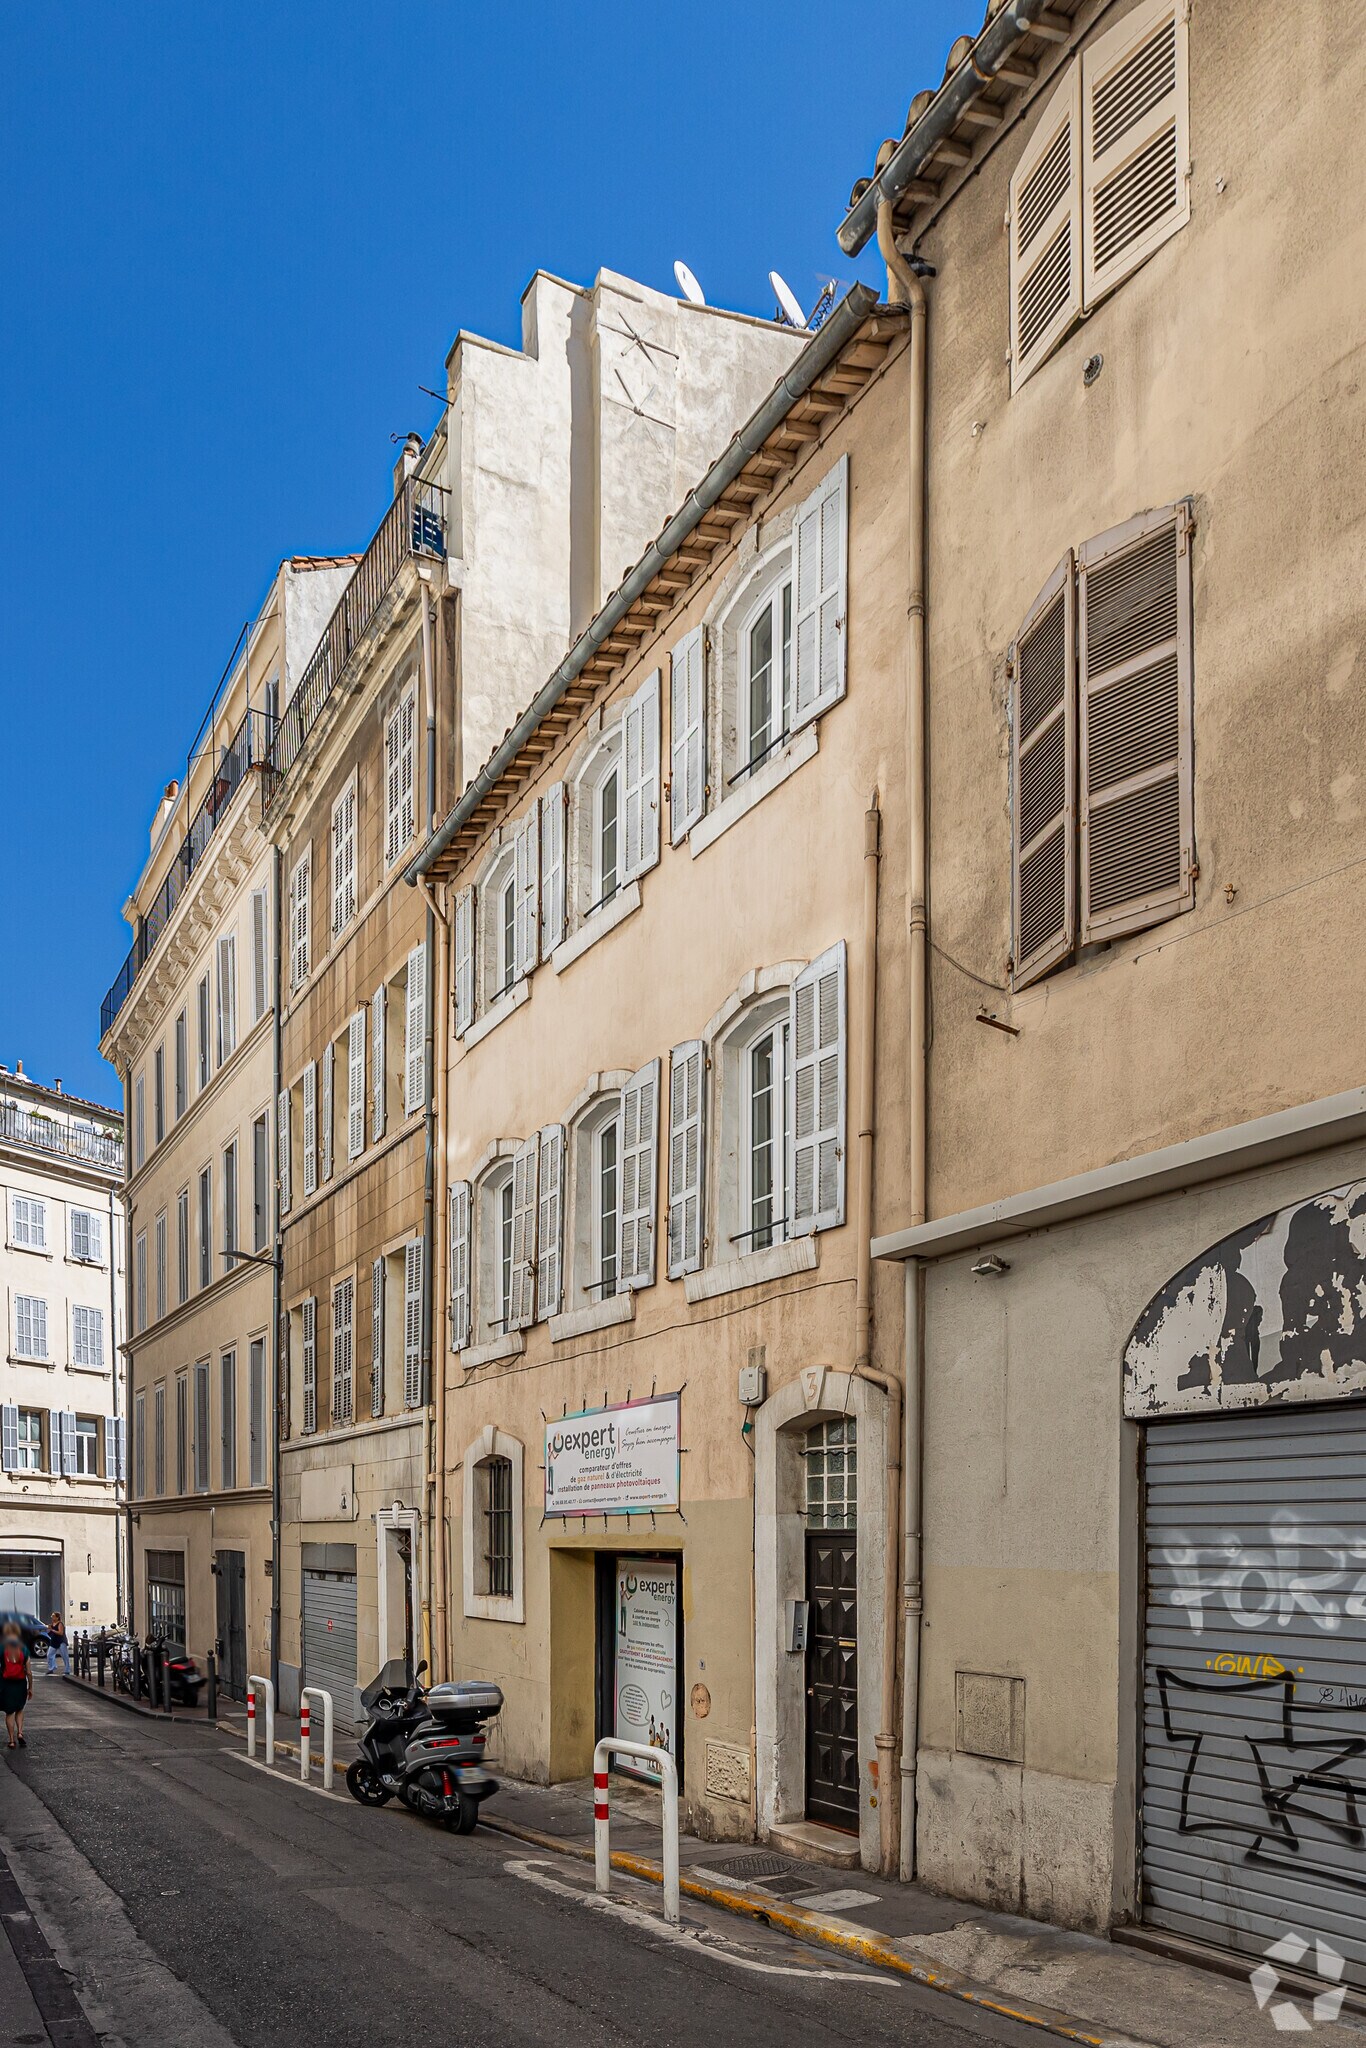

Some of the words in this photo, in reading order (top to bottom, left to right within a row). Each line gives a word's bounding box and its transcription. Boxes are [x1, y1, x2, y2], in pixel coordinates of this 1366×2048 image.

[806, 1372, 818, 1402] 3
[565, 1422, 615, 1454] expert
[584, 1446, 617, 1460] energy
[579, 1464, 610, 1474] comparateur
[611, 1461, 632, 1470] d'offres
[577, 1475, 586, 1484] gaz
[587, 1472, 605, 1481] naturel
[611, 1468, 643, 1479] d'électricité
[591, 1482, 615, 1491] panneaux
[616, 1477, 661, 1489] photovoltaïques
[640, 1580, 675, 1596] expert
[653, 1594, 676, 1604] energy
